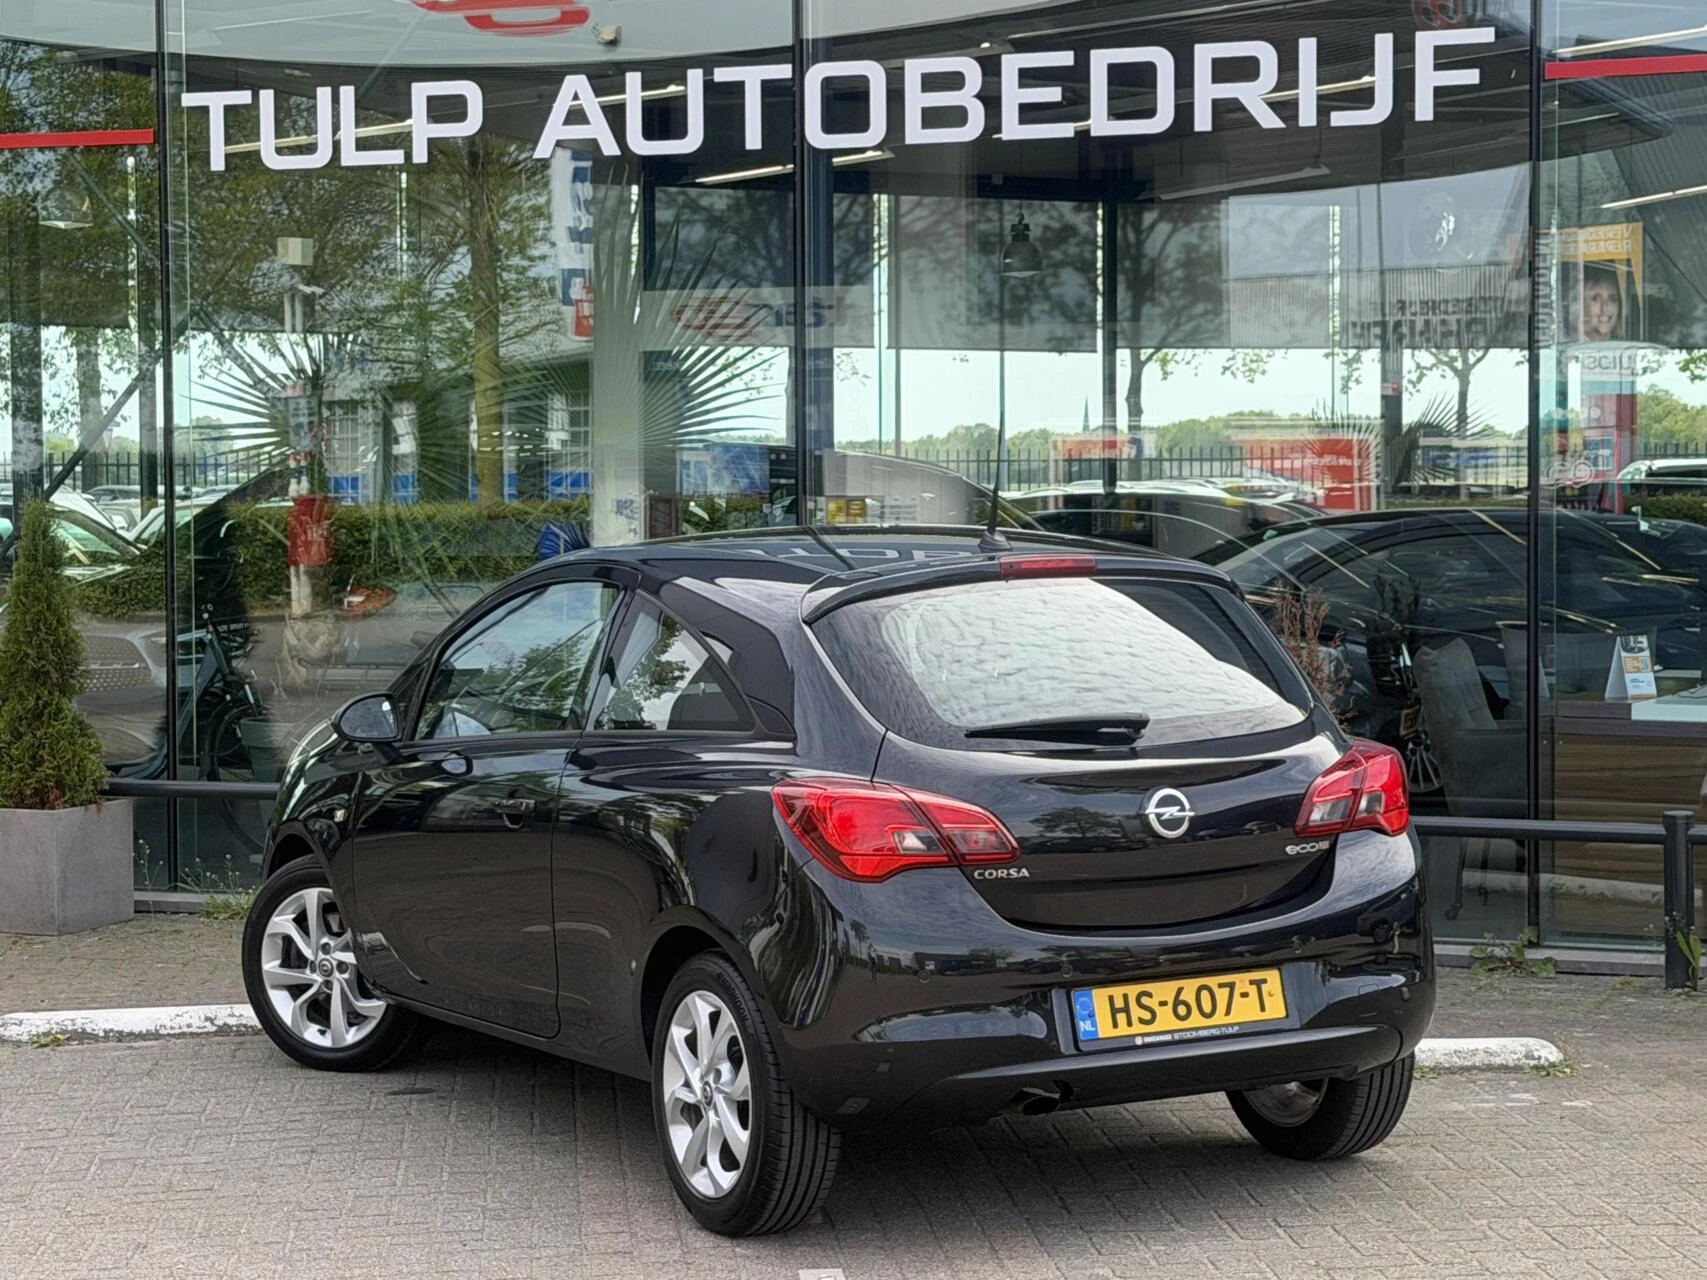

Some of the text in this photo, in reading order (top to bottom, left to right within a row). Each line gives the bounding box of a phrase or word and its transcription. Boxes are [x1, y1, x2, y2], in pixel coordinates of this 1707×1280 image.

[181, 27, 1496, 171] TULP AUTOBEDRIJF
[973, 867, 1031, 880] CORSA
[1108, 978, 1267, 1029] HS-607-T
[1079, 1020, 1096, 1032] NL
